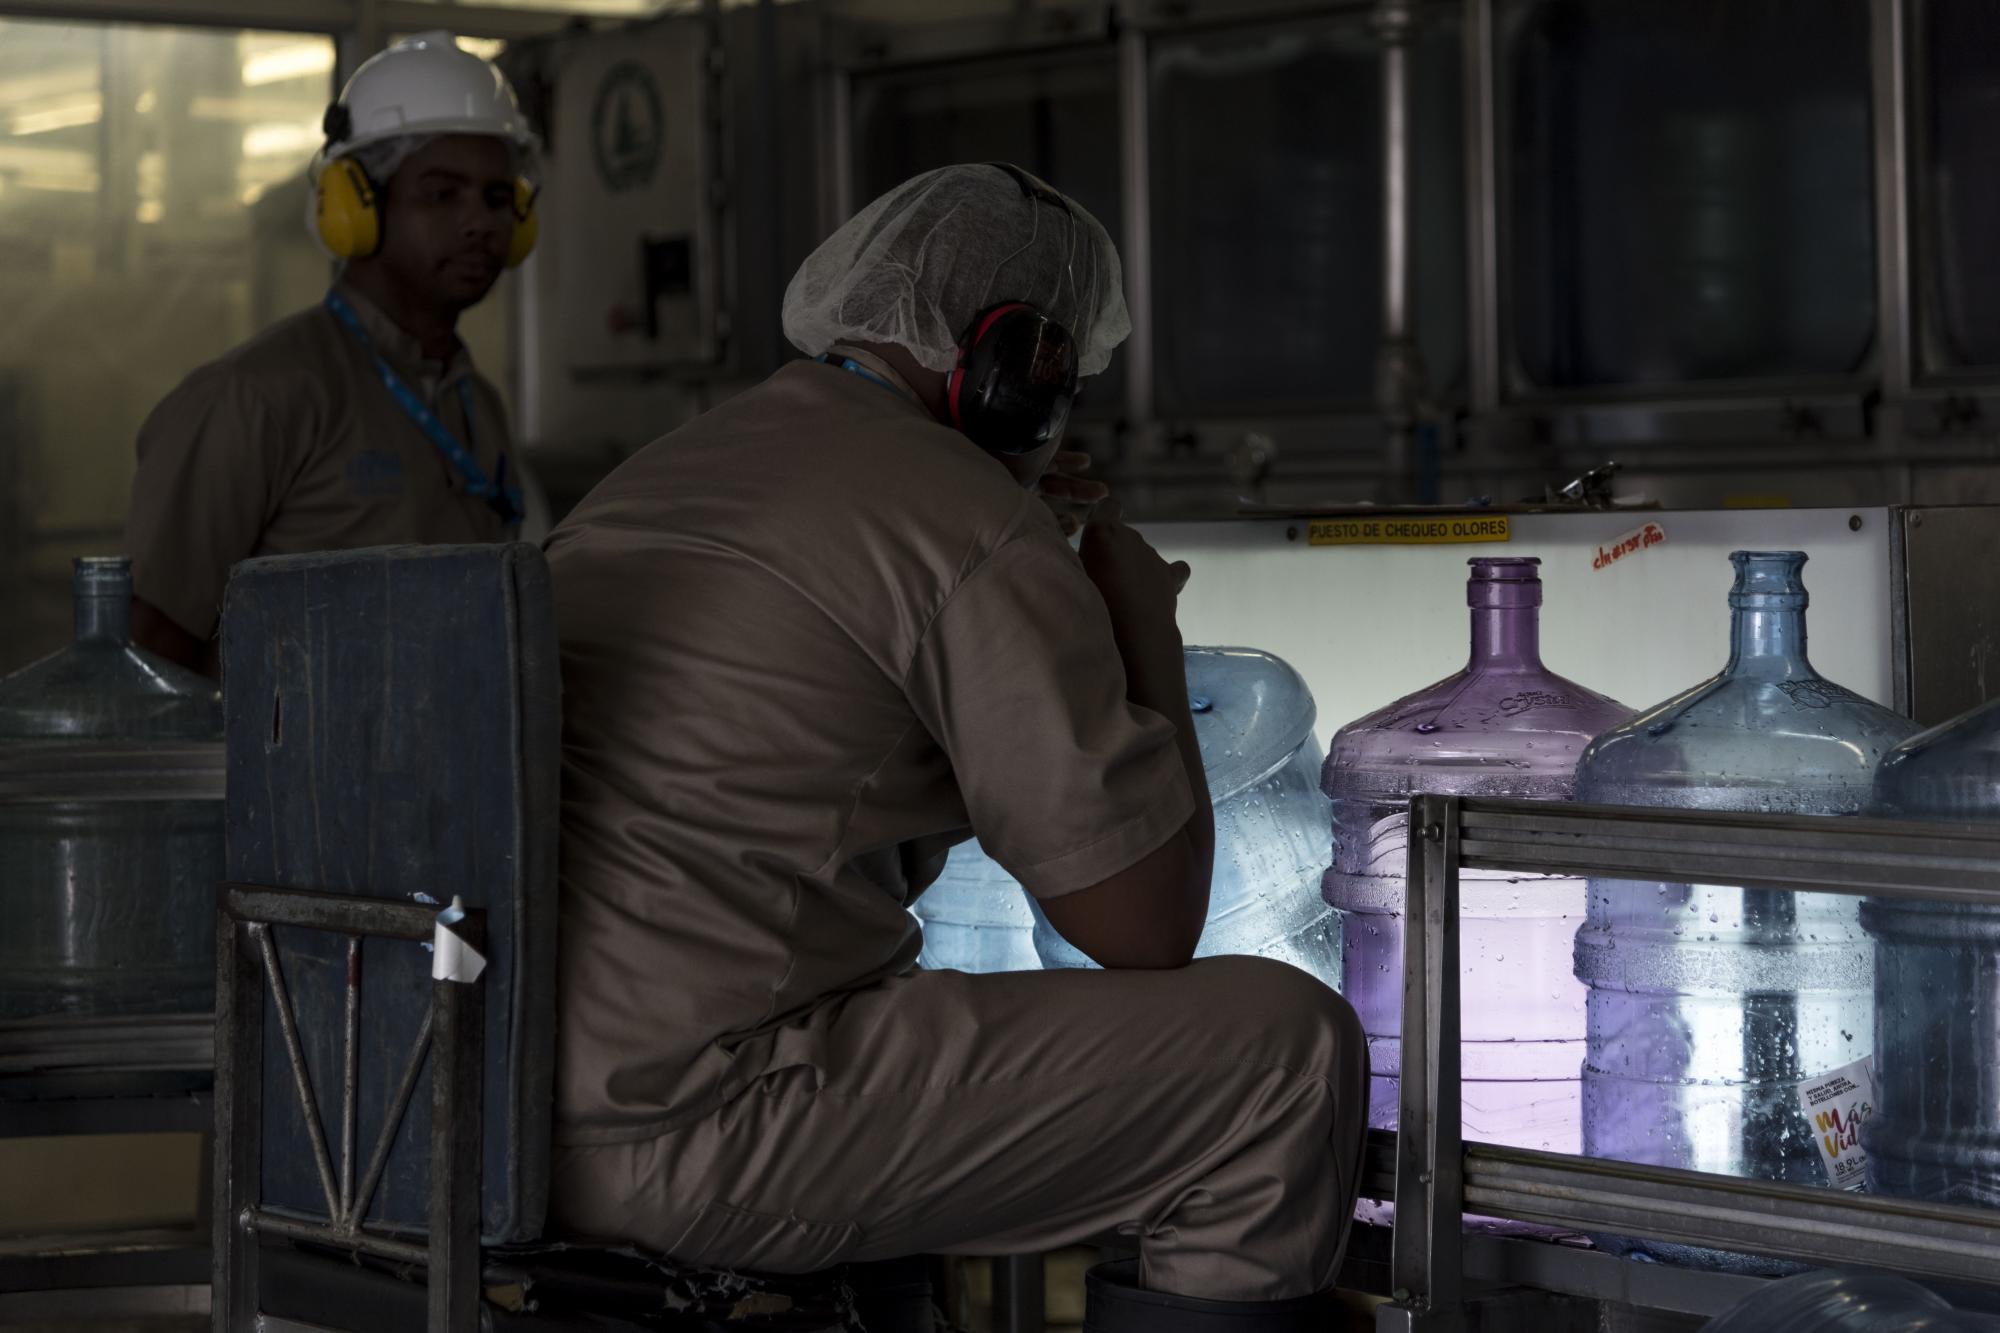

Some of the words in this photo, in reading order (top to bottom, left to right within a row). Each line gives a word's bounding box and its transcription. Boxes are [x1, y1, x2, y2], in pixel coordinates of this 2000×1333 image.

[1310, 523, 1357, 538] PUESTO
[1364, 523, 1380, 537] DE
[1385, 523, 1447, 538] CHEQUEO
[1453, 520, 1506, 536] OLORES
[1810, 1089, 1844, 1106] BOTELLONES
[1815, 1102, 1872, 1133] Más
[1824, 1122, 1860, 1158] Vid
